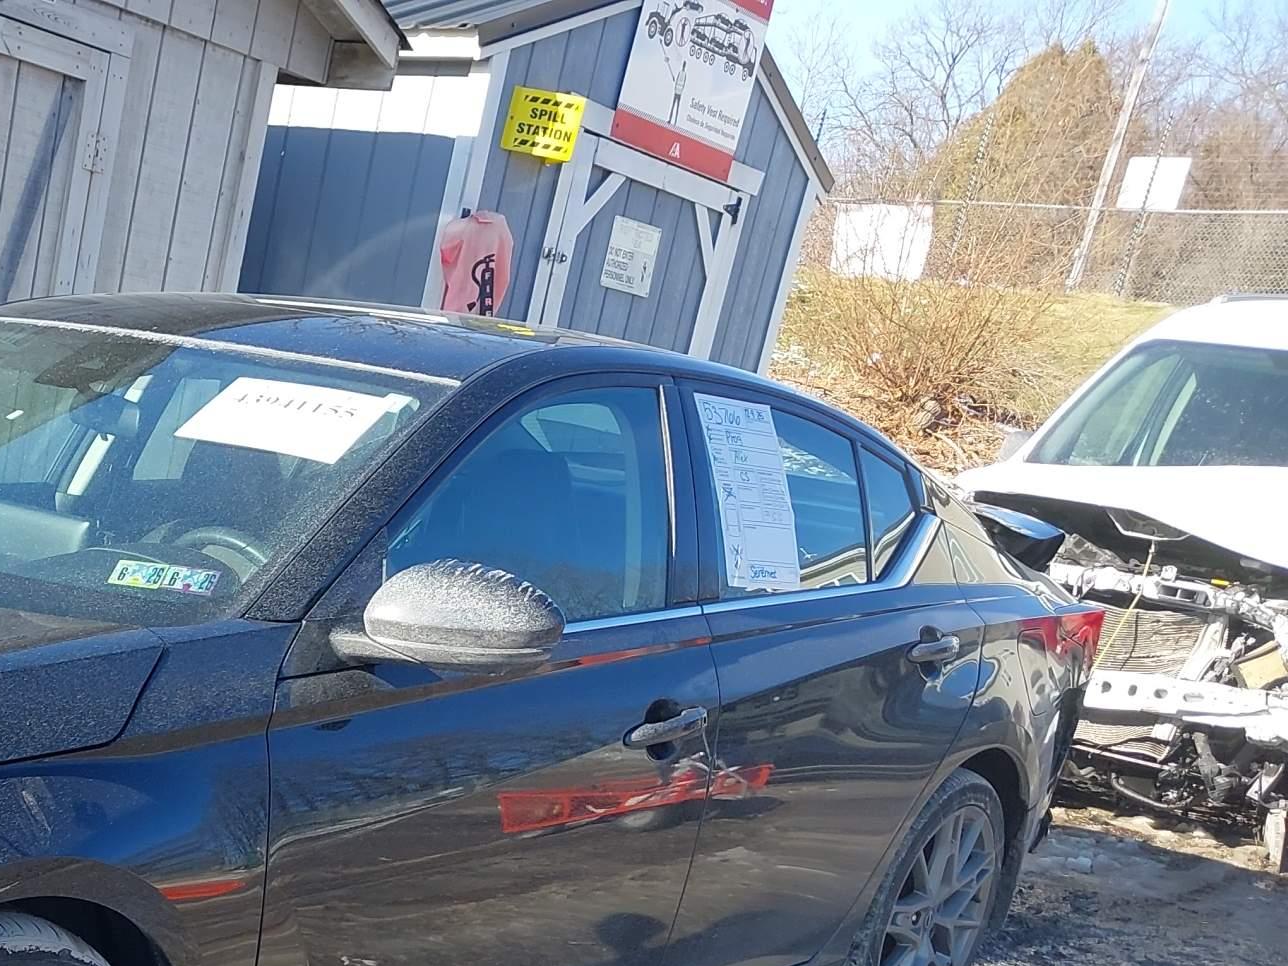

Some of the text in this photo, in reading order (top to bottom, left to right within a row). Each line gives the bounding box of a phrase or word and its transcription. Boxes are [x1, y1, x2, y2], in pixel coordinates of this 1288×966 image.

[529, 107, 566, 124] SPILL
[689, 97, 740, 127] Safety Vest Required
[516, 121, 572, 142] STATION
